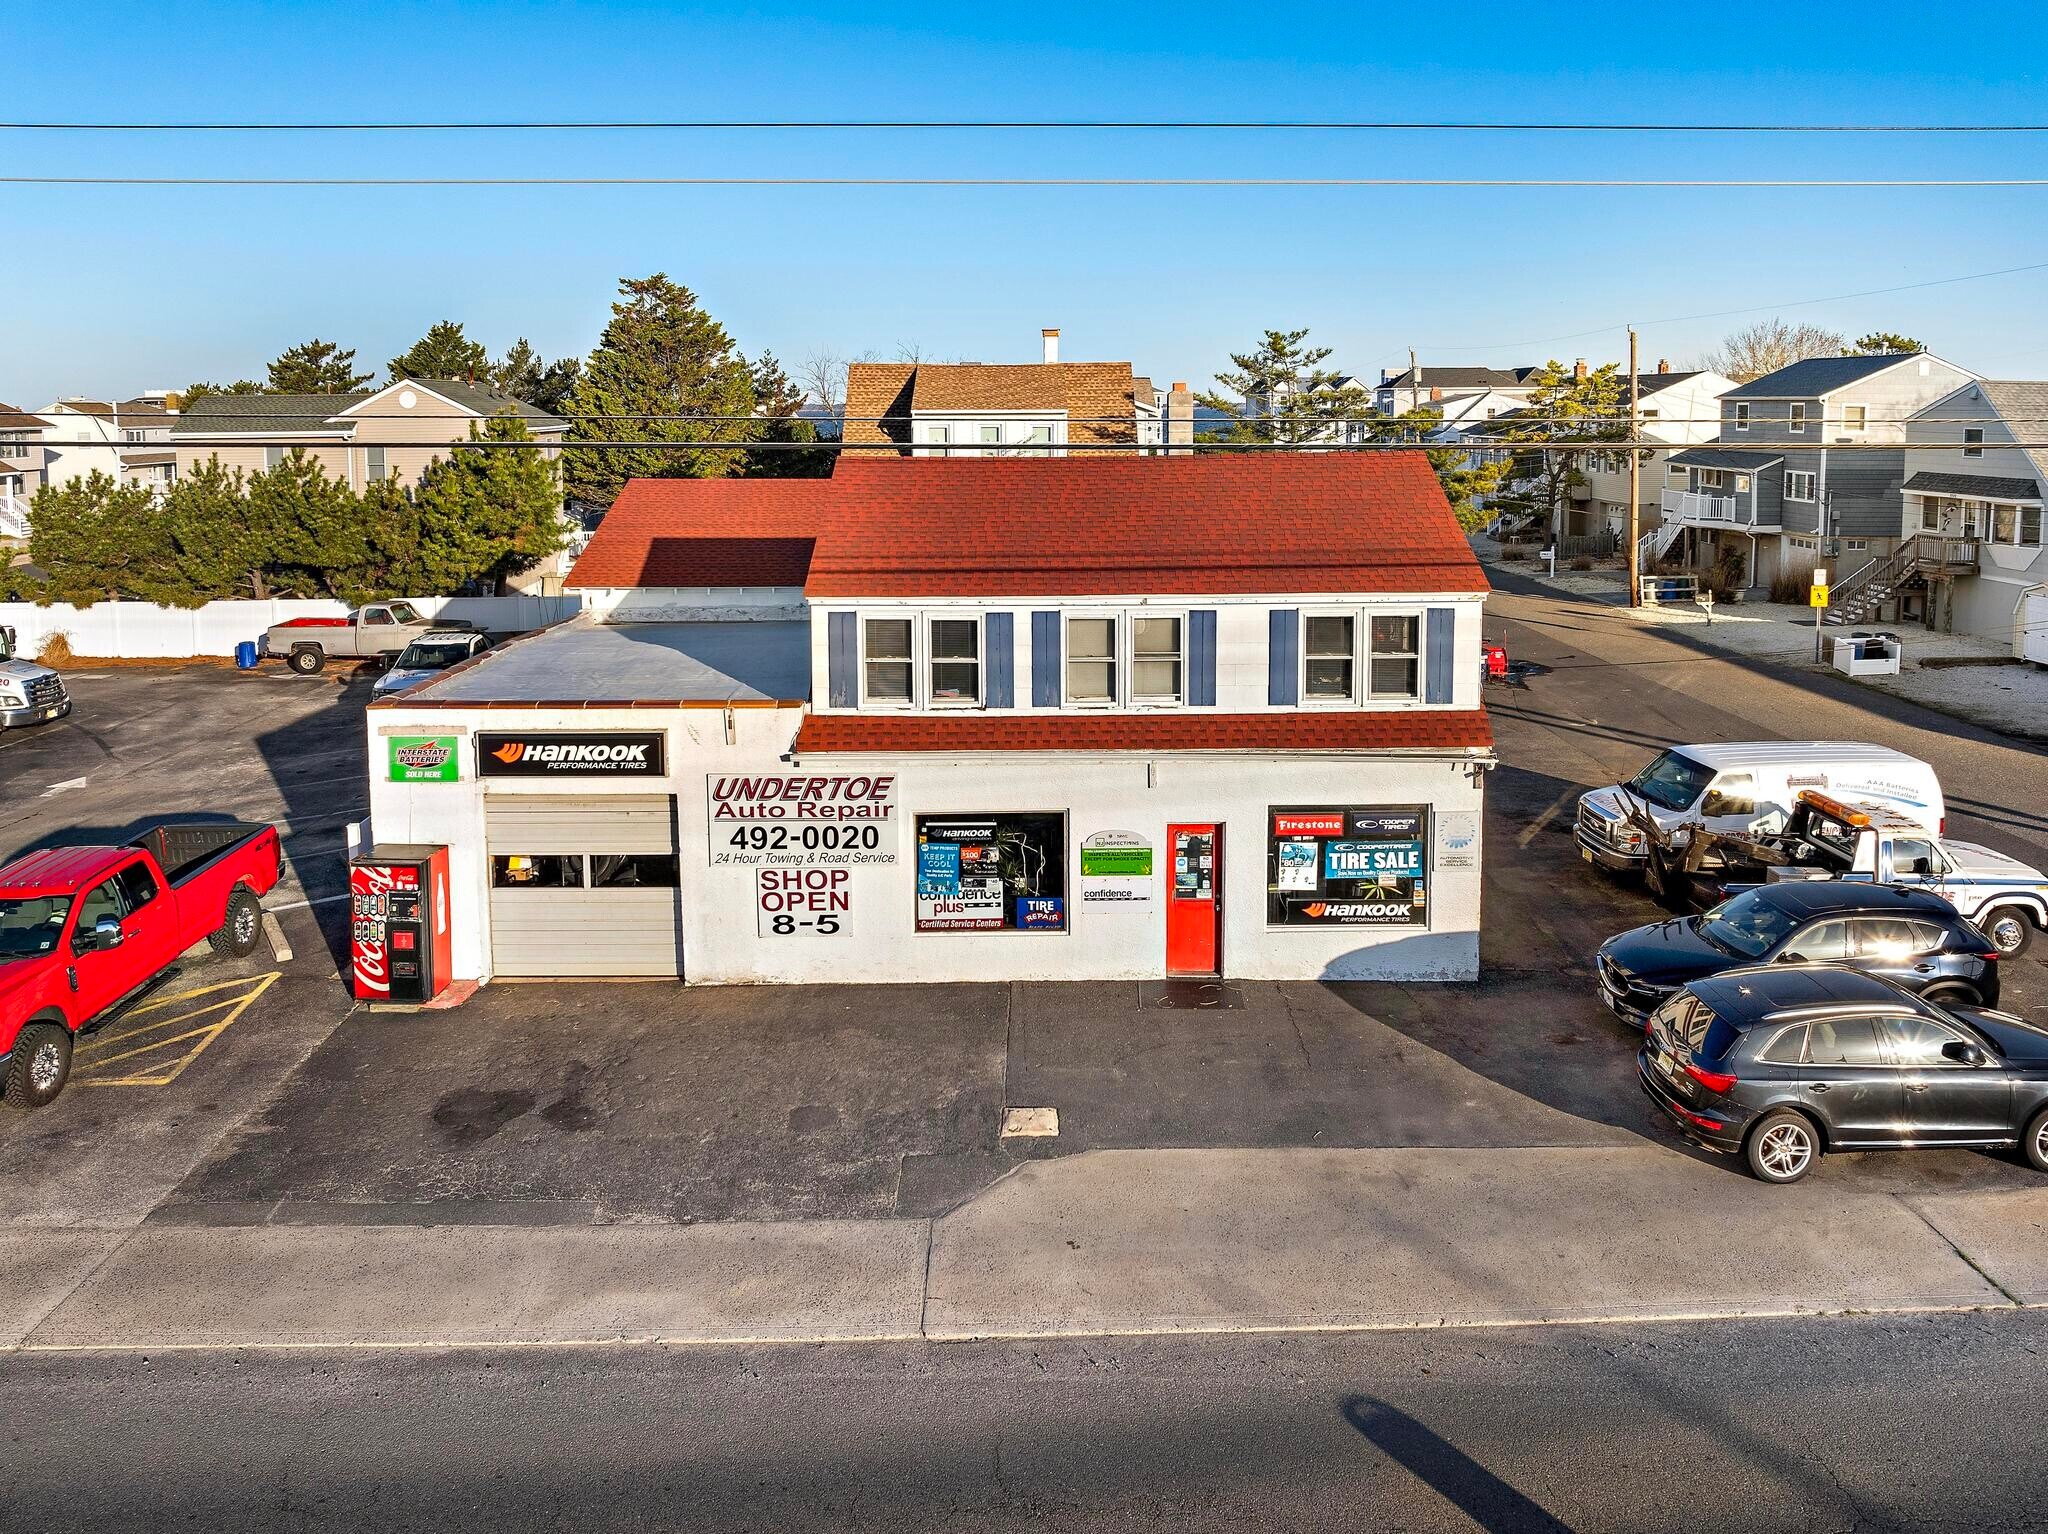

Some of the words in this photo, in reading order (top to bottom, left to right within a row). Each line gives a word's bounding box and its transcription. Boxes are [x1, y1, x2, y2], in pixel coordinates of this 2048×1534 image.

[712, 777, 895, 801] UNDERTOE
[1836, 782, 1870, 790] Delivered
[1886, 788, 1918, 800] Installed
[1886, 782, 1919, 794] Batteries
[714, 802, 786, 818] Auto
[797, 801, 894, 821] Repair
[1278, 820, 1341, 830] Firestone
[730, 825, 880, 850] 492-0020
[715, 853, 730, 863] 24
[732, 853, 762, 863] Hour
[765, 853, 804, 866] Towing
[807, 853, 815, 863] &
[819, 852, 851, 863] Road
[852, 852, 895, 863] Service
[1328, 852, 1370, 869] TIRE
[1373, 851, 1419, 869] SALE
[761, 869, 849, 890] SHOP
[761, 891, 849, 911] OPEN
[1084, 889, 1132, 897] confidence
[934, 900, 965, 916] plus
[1027, 901, 1054, 913] TIRE
[772, 914, 840, 934] 8-5
[921, 920, 950, 928] Certified
[950, 920, 975, 928] Service
[976, 920, 1001, 928] Centers
[1025, 913, 1059, 921] REPAIR
